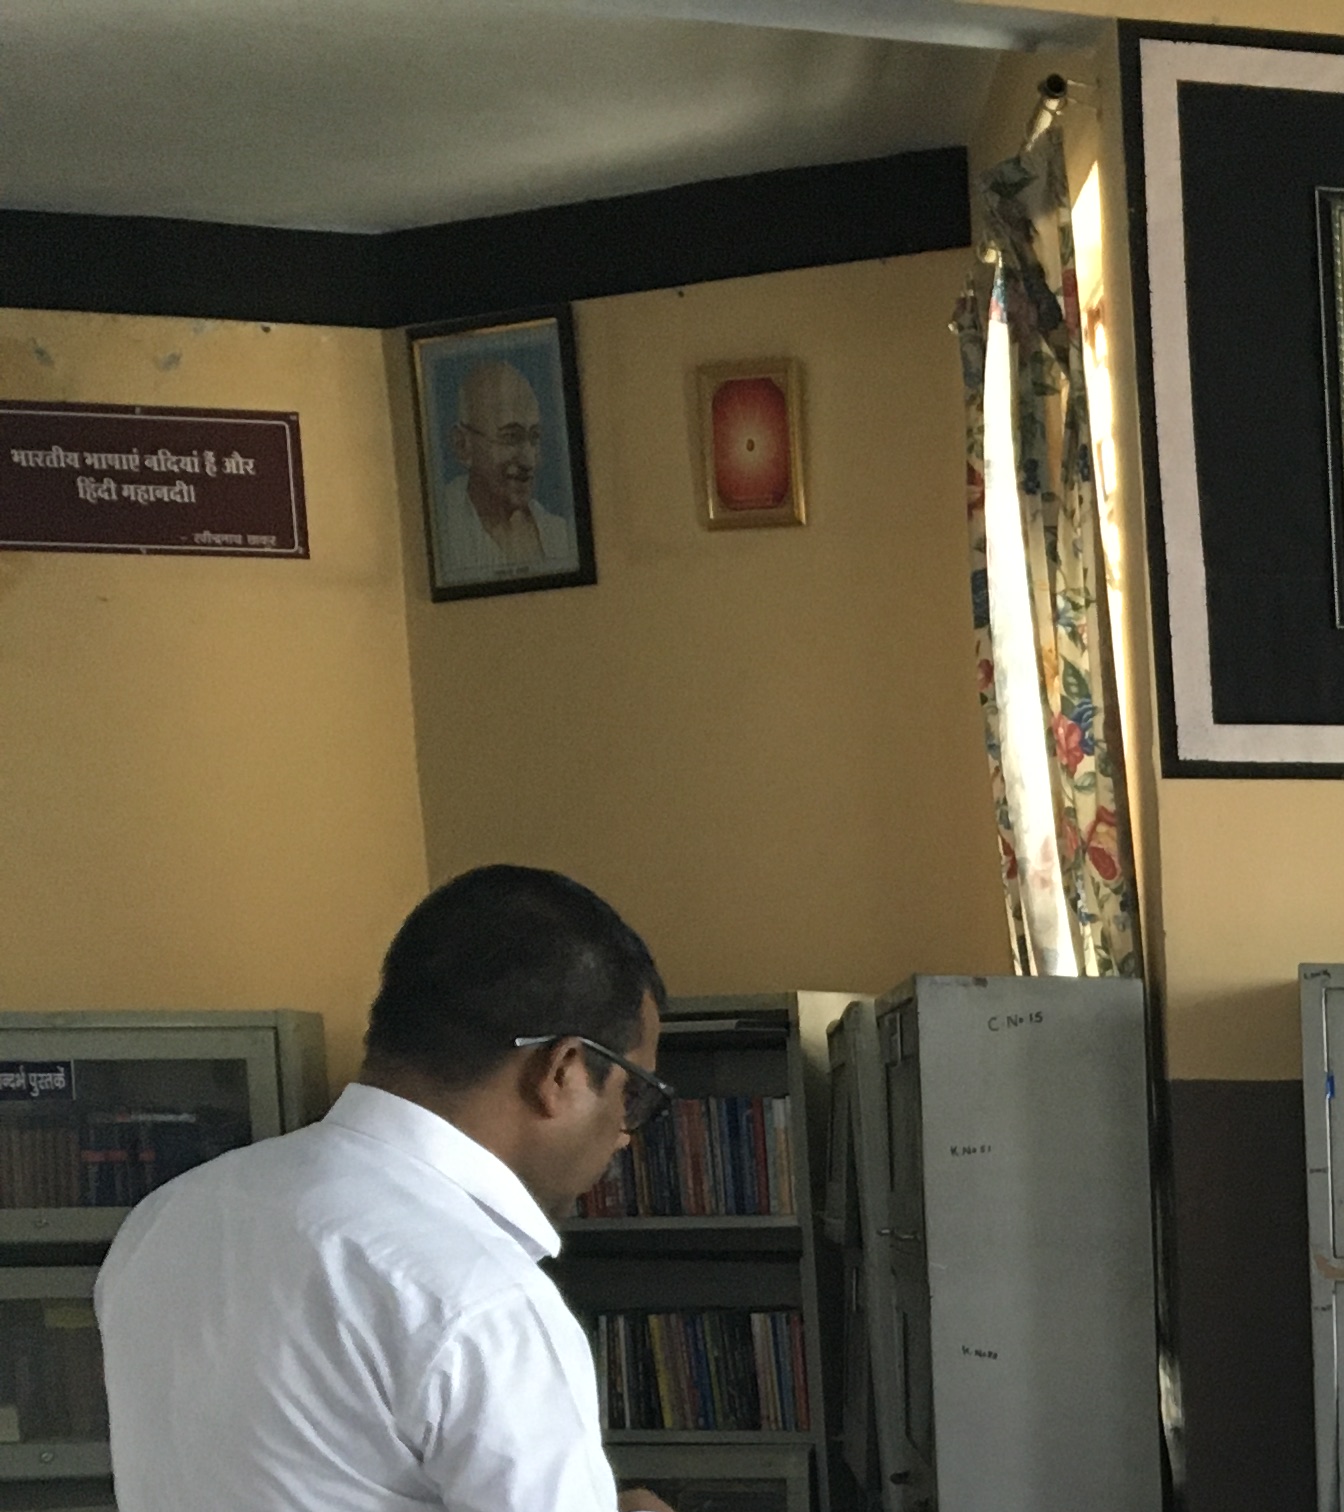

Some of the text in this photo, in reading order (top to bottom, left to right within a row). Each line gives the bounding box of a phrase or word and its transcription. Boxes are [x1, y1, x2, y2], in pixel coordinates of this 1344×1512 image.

[11, 445, 80, 469] भारतीय
[221, 451, 256, 475] और
[77, 476, 118, 503] हिंदी
